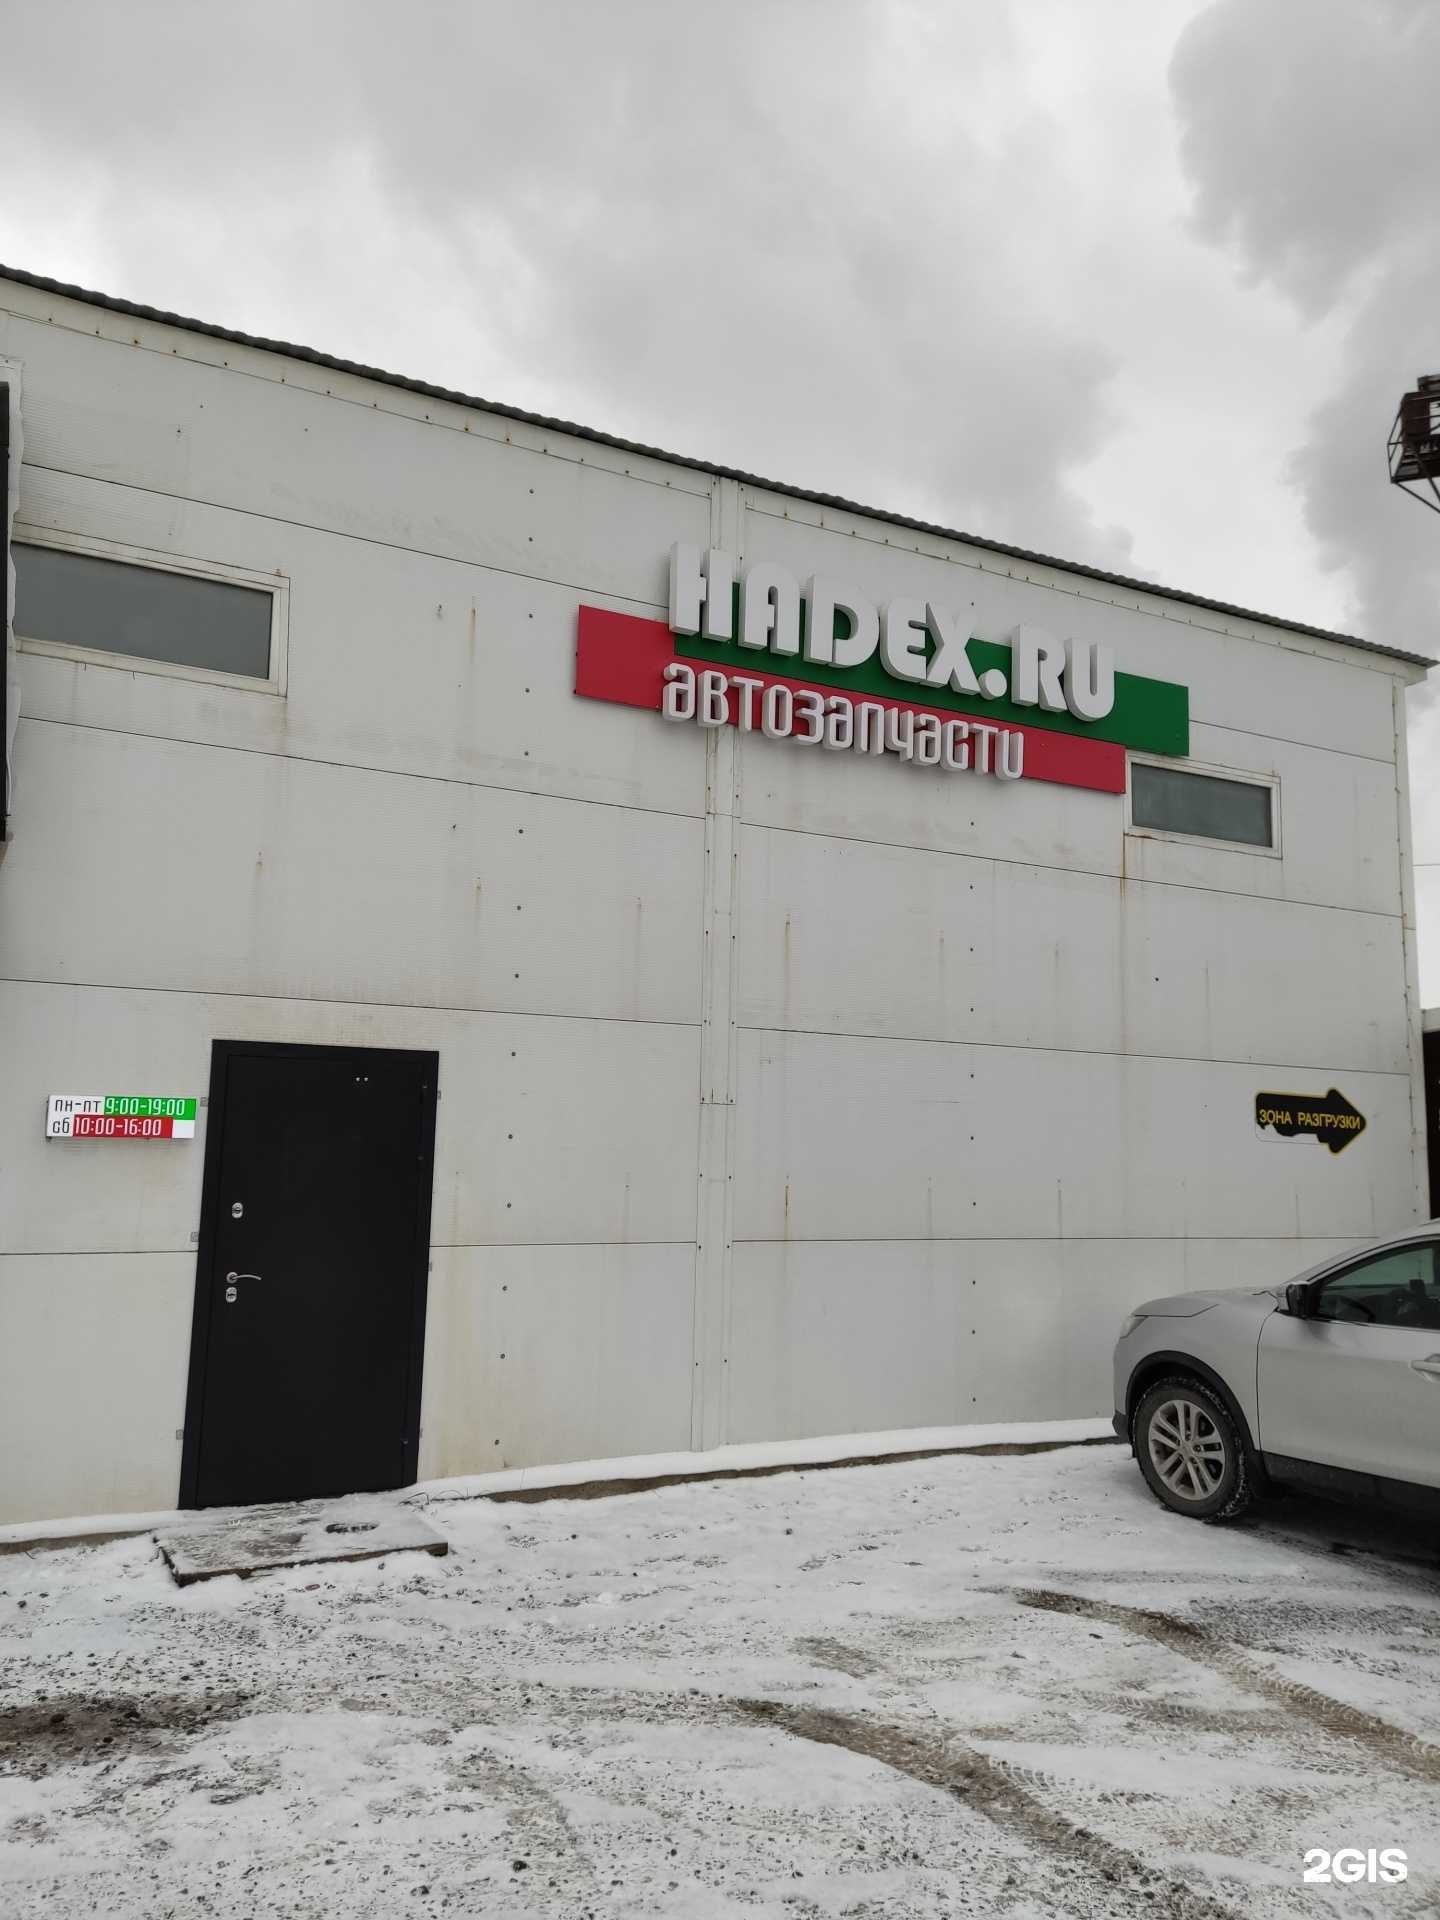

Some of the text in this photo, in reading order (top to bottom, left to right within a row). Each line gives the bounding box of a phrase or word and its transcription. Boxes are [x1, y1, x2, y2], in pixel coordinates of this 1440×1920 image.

[668, 541, 1115, 722] HADEX.RU
[105, 1098, 185, 1116] 9:00-19:00
[52, 1117, 162, 1136] сб 10:00-16:00
[1259, 1109, 1360, 1130] ЗОНА РАЗГРУЗКИ
